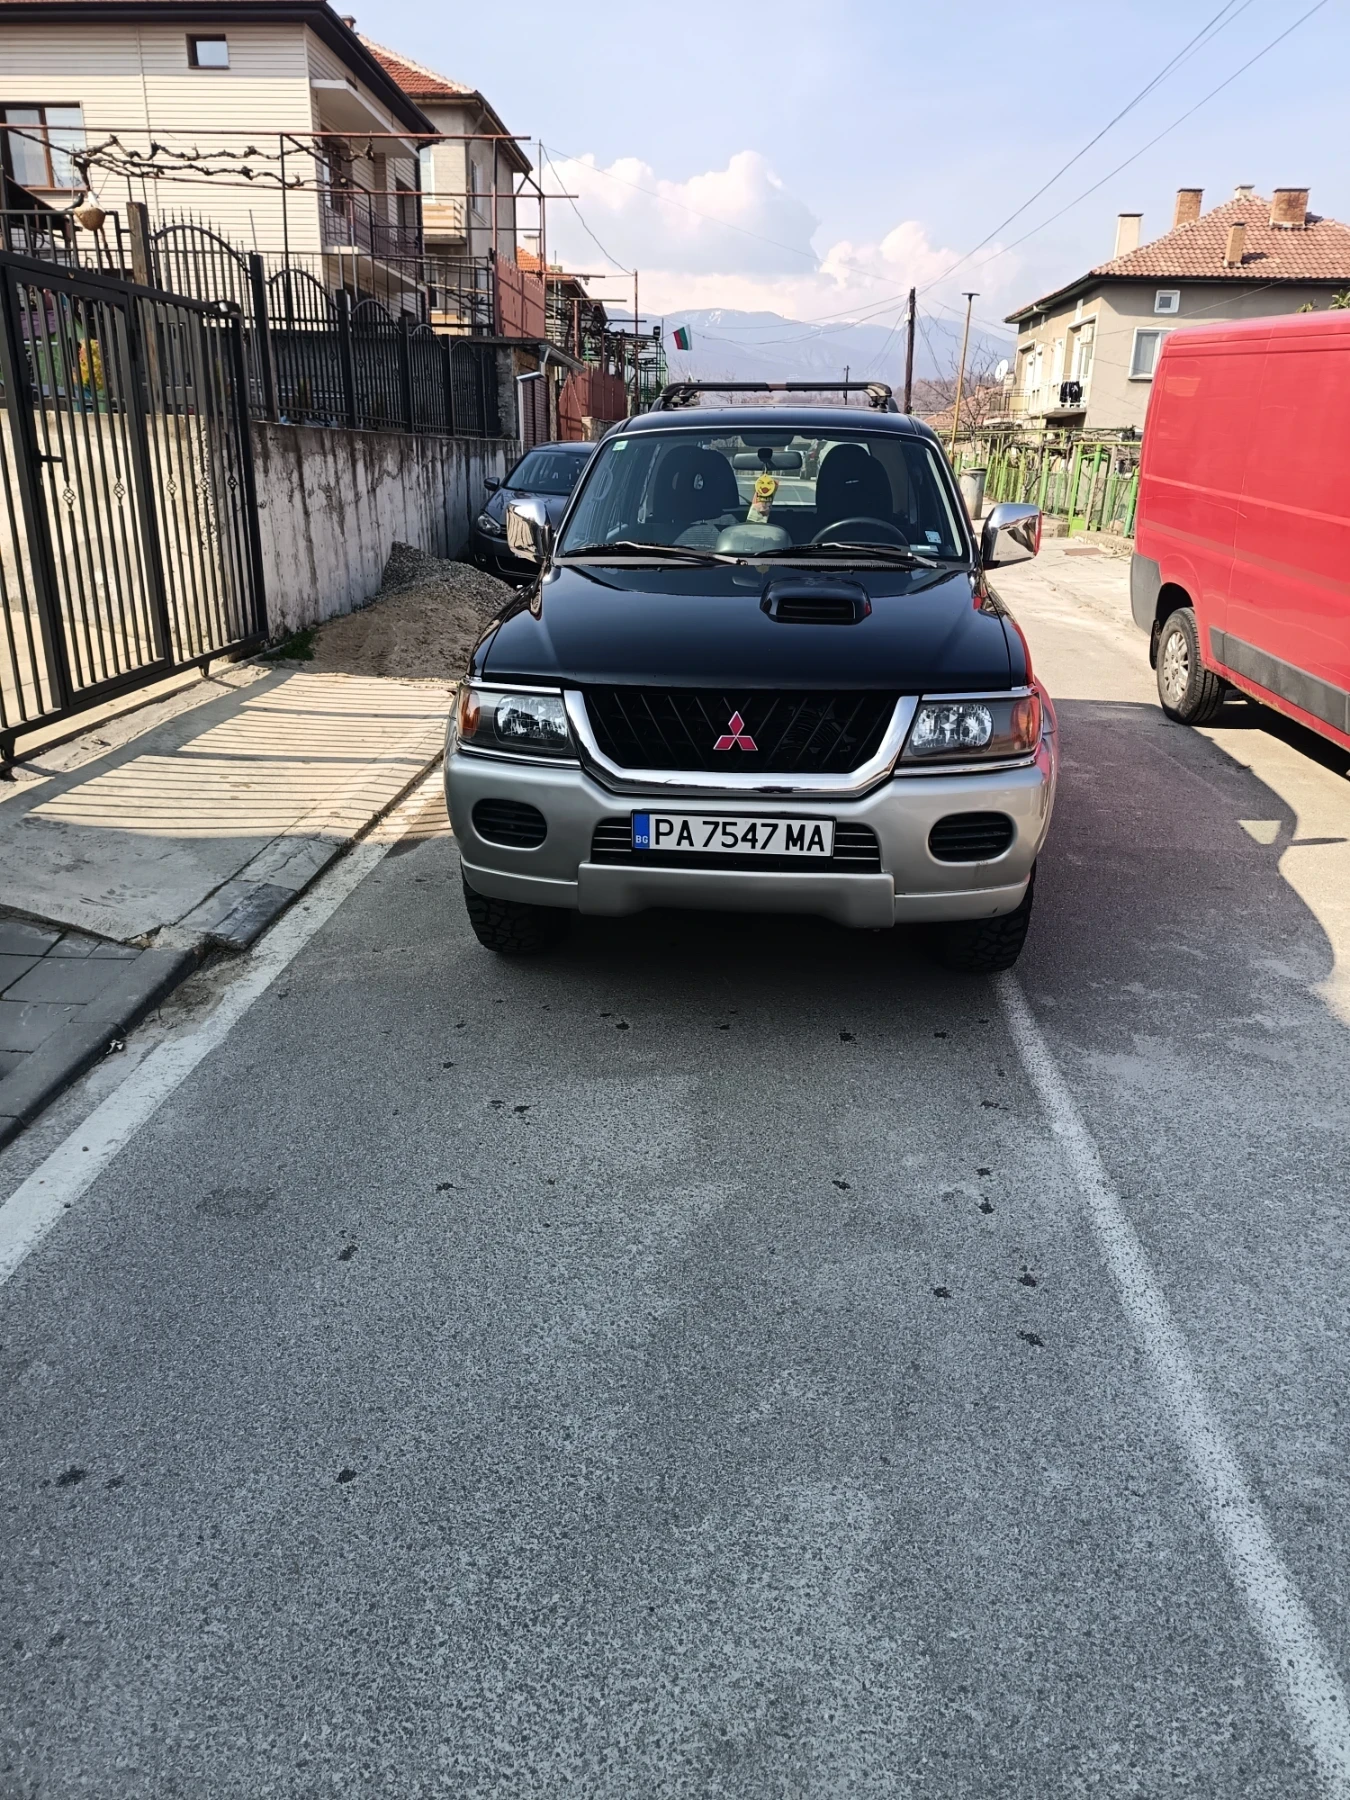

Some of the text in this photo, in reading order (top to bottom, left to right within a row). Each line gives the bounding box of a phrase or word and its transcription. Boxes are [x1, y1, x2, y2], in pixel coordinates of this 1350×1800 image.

[635, 835, 649, 844] BG
[654, 818, 825, 852] PA 7547 MA
